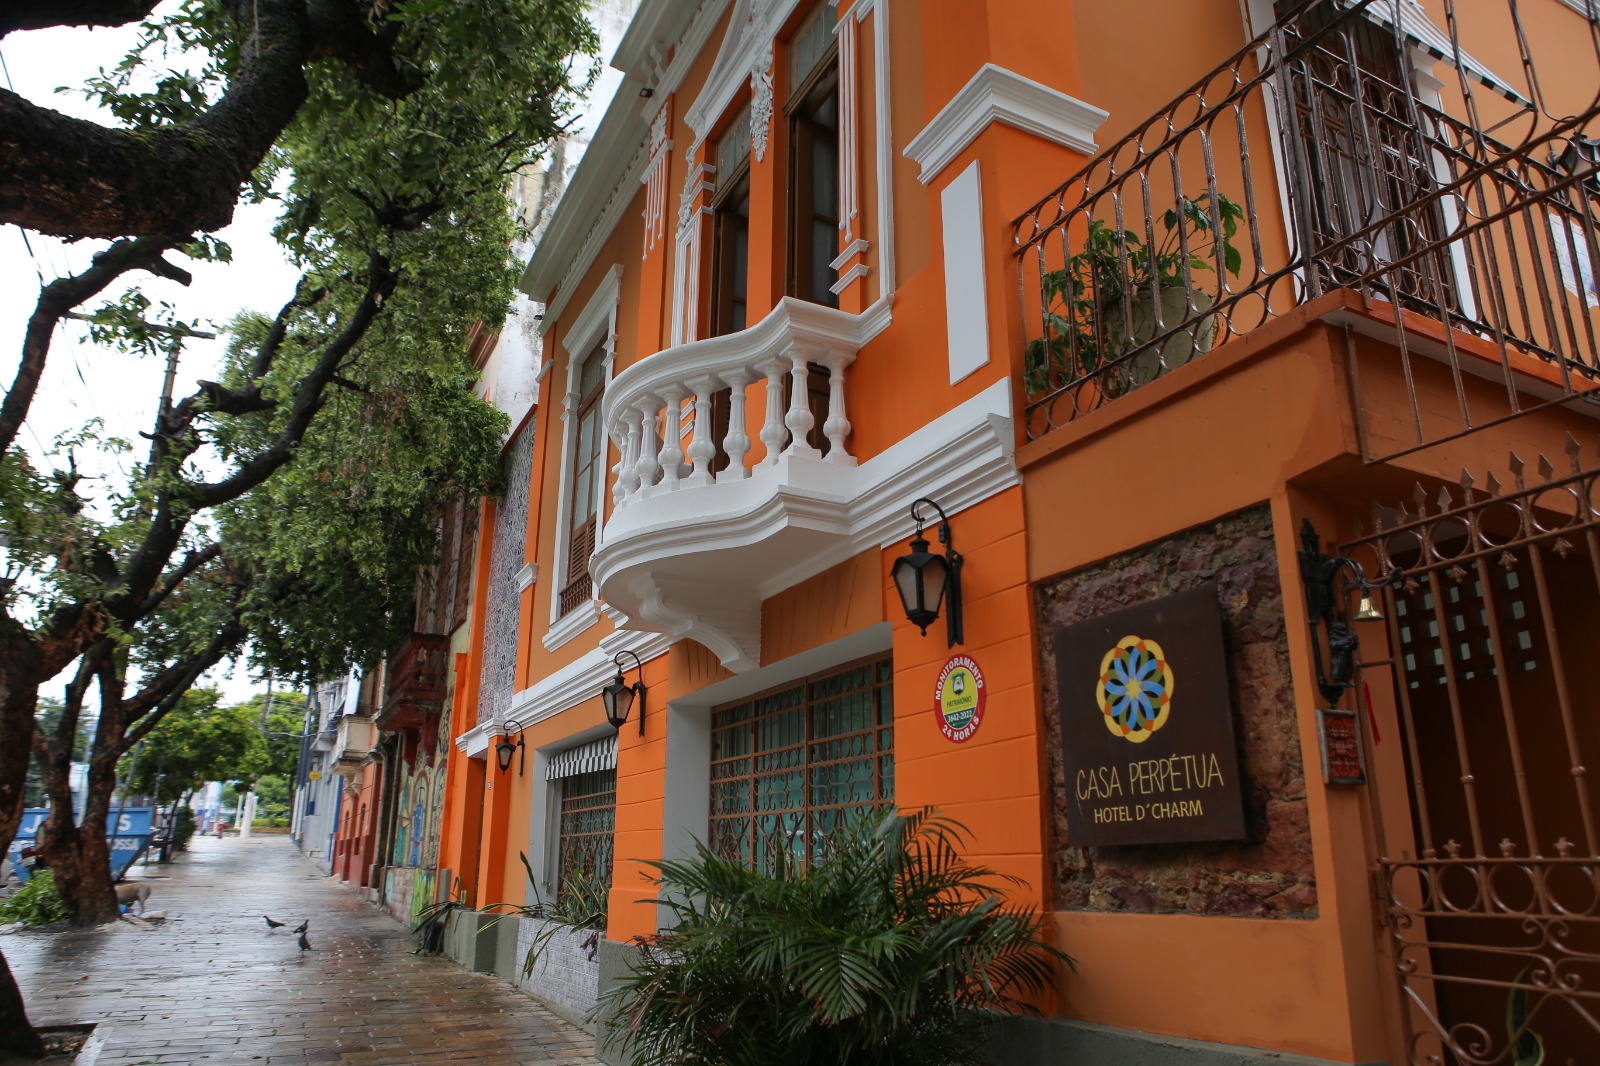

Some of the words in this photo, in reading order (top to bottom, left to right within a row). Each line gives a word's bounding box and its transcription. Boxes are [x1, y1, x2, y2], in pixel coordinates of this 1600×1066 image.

[936, 657, 983, 700] MONITORAMENTO
[942, 725, 952, 738] 24
[953, 716, 979, 740] HORAS
[947, 710, 973, 723] 3642-2022
[1076, 766, 1123, 800] CASA
[1129, 753, 1224, 795] PERPÉTUA
[1094, 806, 1133, 823] HOTEL
